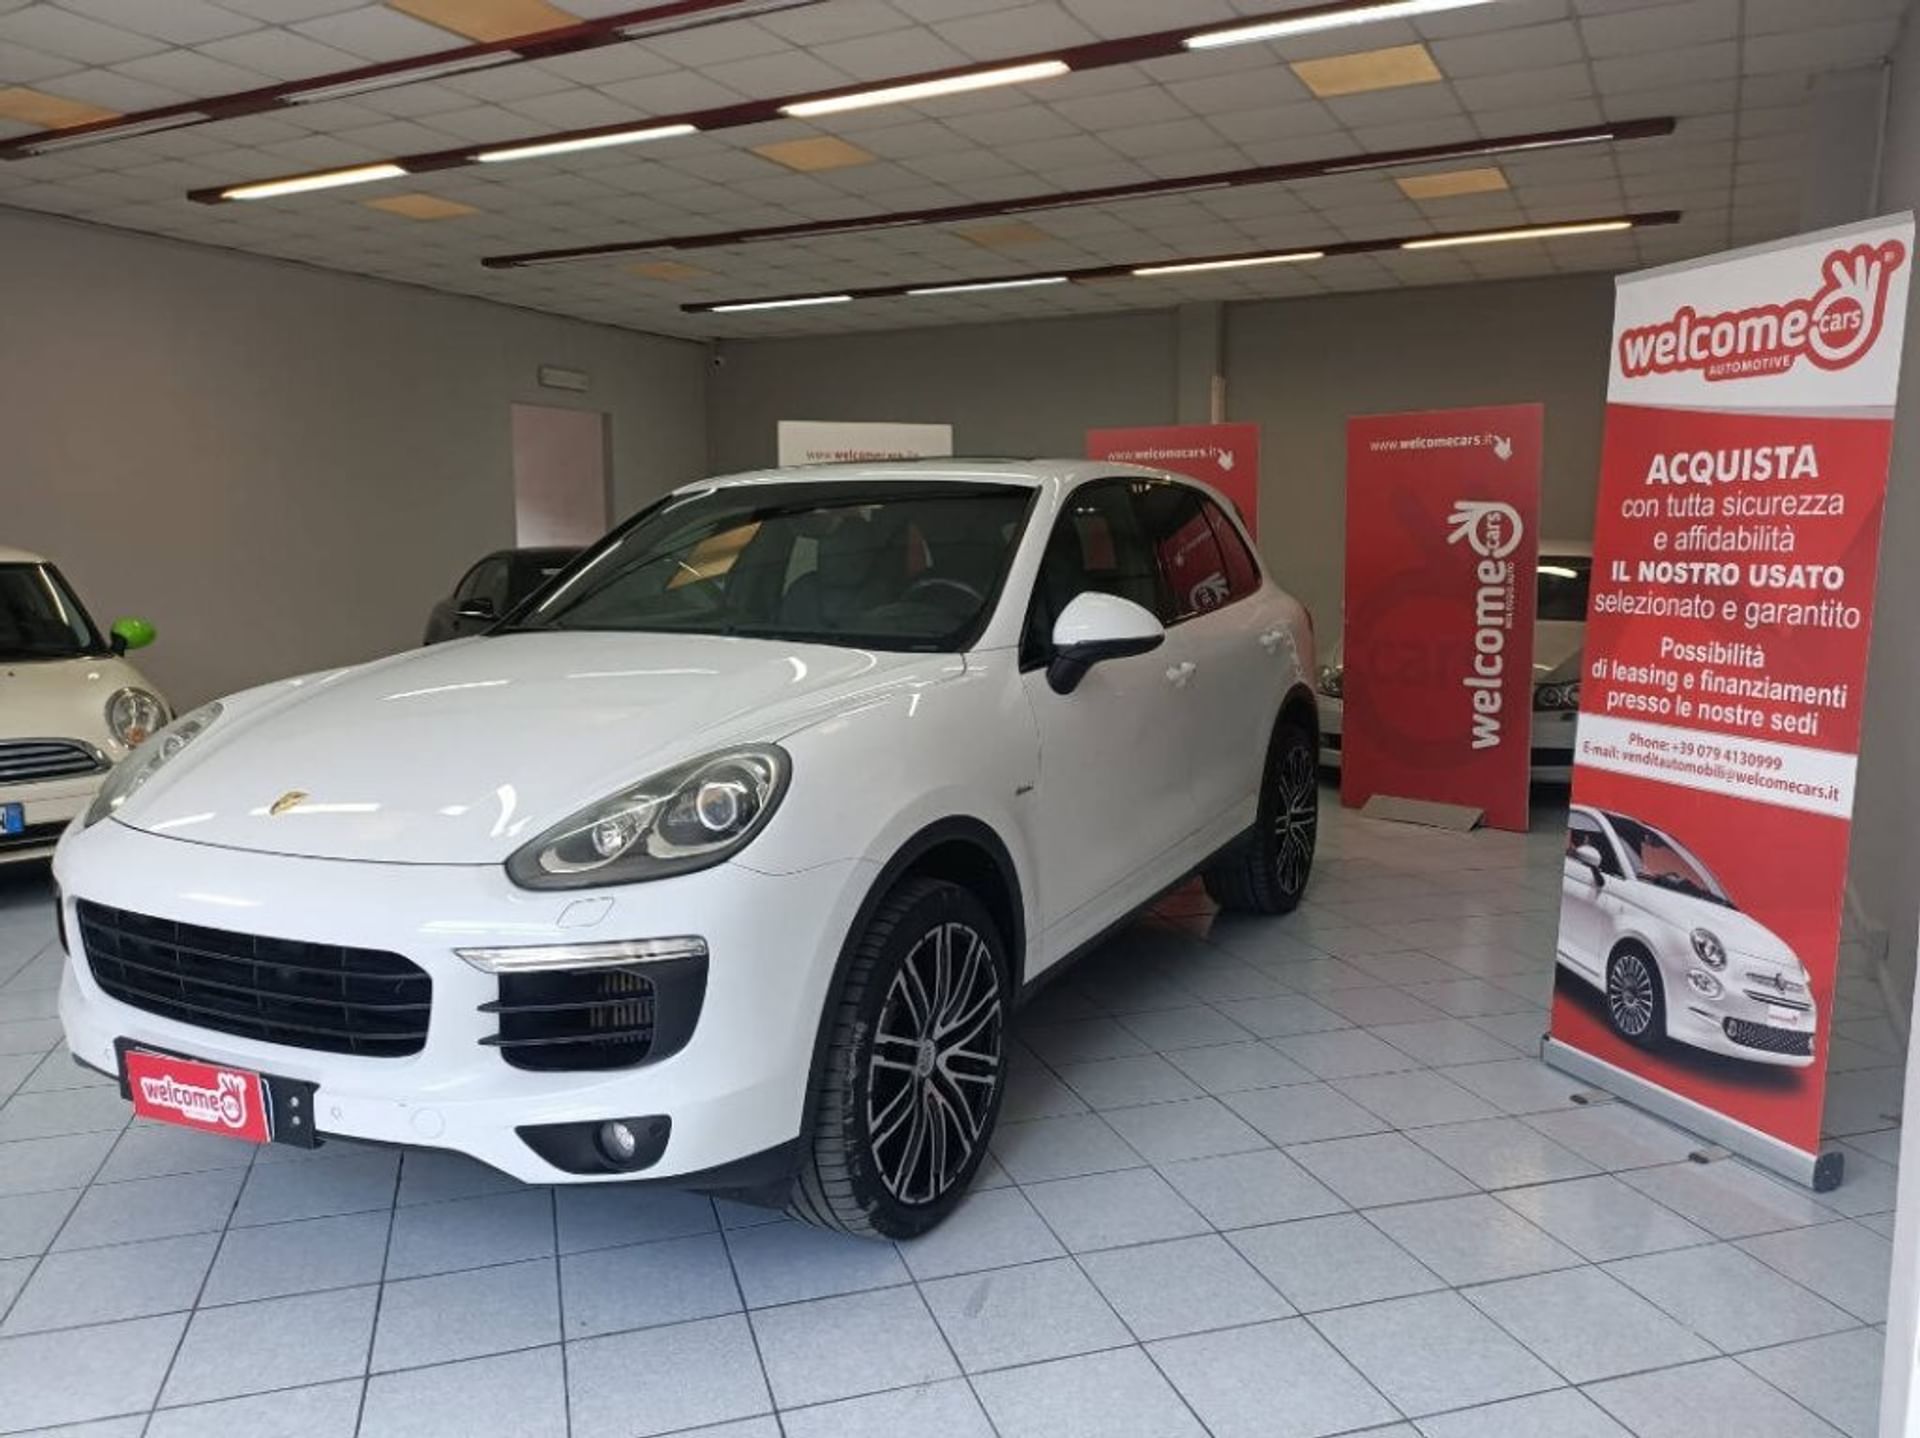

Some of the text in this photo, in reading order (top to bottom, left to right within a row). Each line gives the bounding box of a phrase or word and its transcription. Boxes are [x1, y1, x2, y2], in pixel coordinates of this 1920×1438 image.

[1624, 308, 1862, 370] welcome cars
[1709, 355, 1791, 376] AUTOMOTIVE
[1369, 433, 1494, 451] www.welcomecars.it
[1645, 445, 1818, 485] ACQUISTA
[1621, 490, 1844, 518] con tutta sicurezza
[1485, 511, 1501, 550] cars
[1653, 524, 1795, 552] e affidabilità
[1611, 560, 1844, 590] IL NOSTRO USATO
[1594, 590, 1860, 630] selezionato e garantito
[1463, 560, 1507, 750] welcome
[1660, 636, 1765, 669] Possibilità
[1591, 658, 1848, 709] di leasing e finanziamenti
[1606, 690, 1819, 736] presso le nostre sedi
[1583, 739, 1620, 760] E-mail:
[1629, 732, 1783, 771] Phone: +39 079 4130999
[145, 1079, 218, 1111] welcome
